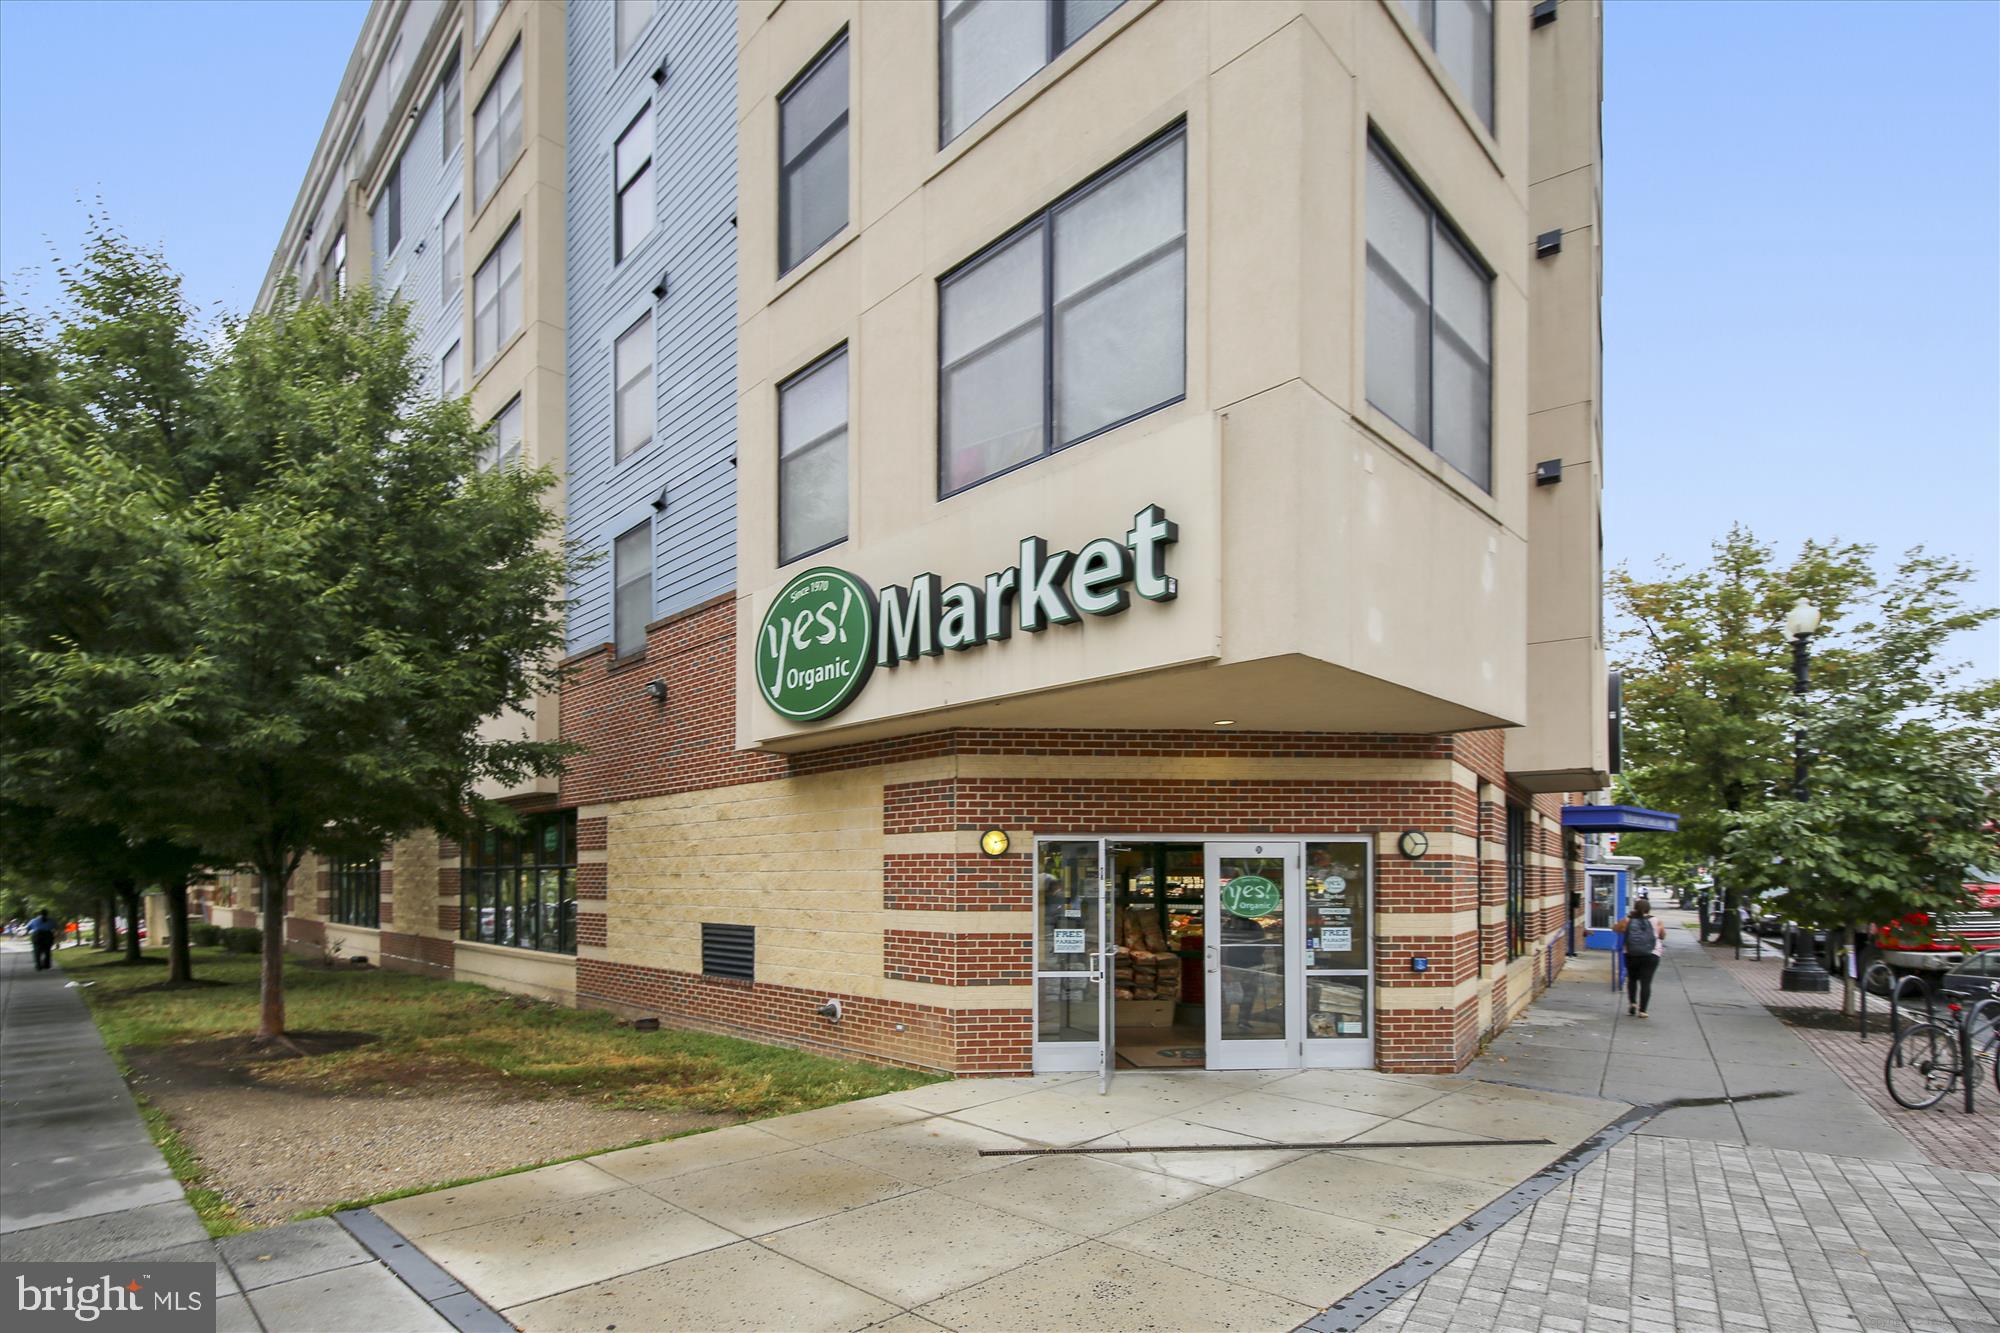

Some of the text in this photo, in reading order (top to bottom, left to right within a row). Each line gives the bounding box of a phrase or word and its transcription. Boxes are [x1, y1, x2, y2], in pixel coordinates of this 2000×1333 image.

[790, 580, 829, 603] Since 1970
[877, 504, 1178, 667] Market
[767, 586, 852, 698] yes!
[786, 656, 850, 690] Organic
[1228, 883, 1271, 910] yes!
[1055, 930, 1083, 938] FREE
[1322, 929, 1349, 937] FREE
